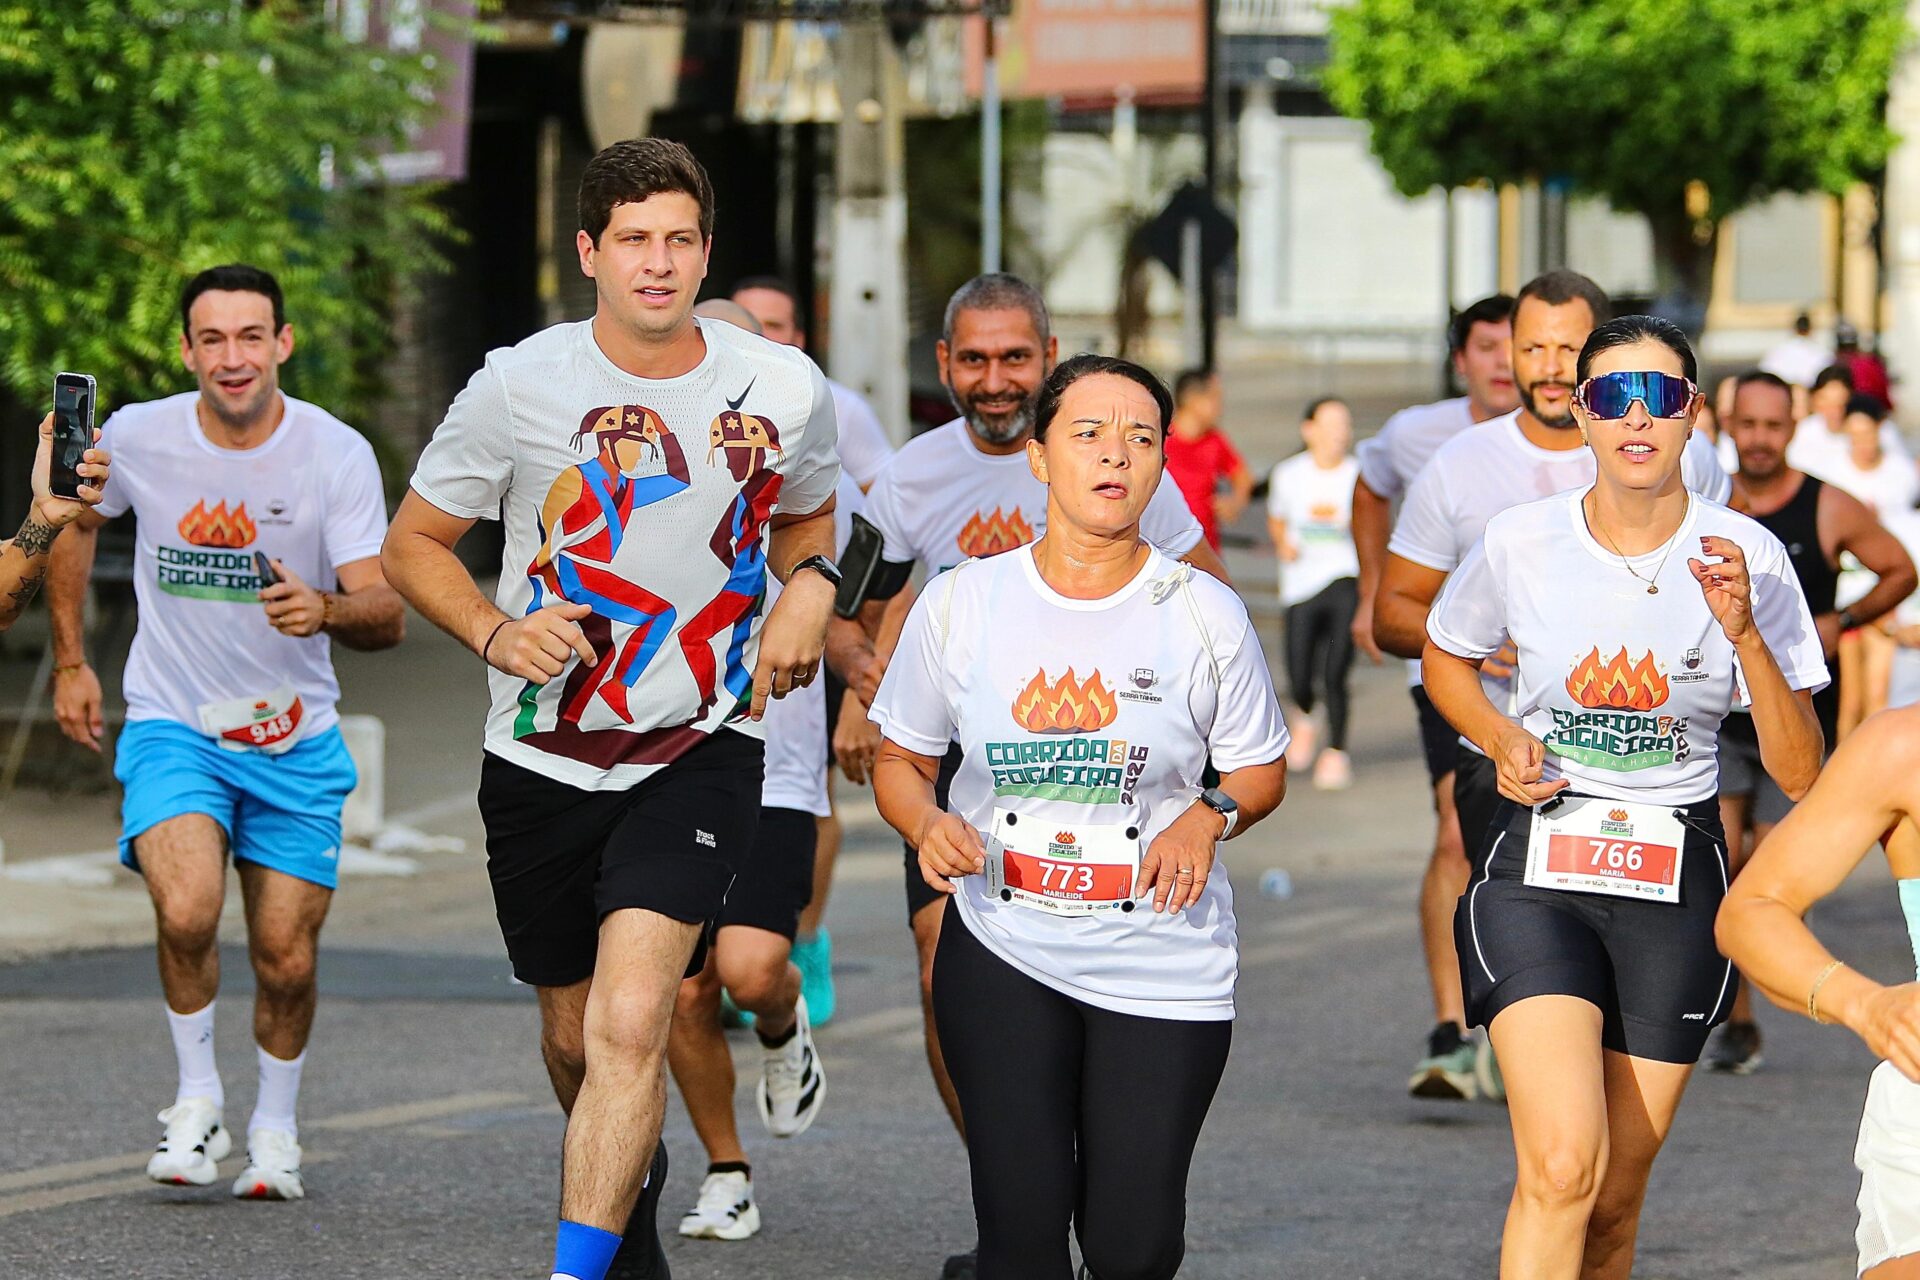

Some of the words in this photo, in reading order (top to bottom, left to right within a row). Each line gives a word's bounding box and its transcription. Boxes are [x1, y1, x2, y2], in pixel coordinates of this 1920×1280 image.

[158, 546, 251, 571] CORRIDA
[158, 565, 265, 590] FOGUEIRA
[1549, 706, 1659, 735] CORRIDA
[985, 738, 1109, 766] CORRIDA
[1111, 743, 1126, 763] DA
[991, 765, 1123, 788] FOGUEIRA
[1121, 745, 1149, 806] 2026
[695, 829, 715, 841] Track
[1588, 840, 1643, 871] 766
[1038, 861, 1095, 892] 773
[1599, 868, 1626, 878] MARIA
[1042, 888, 1084, 900] MARILEIDE
